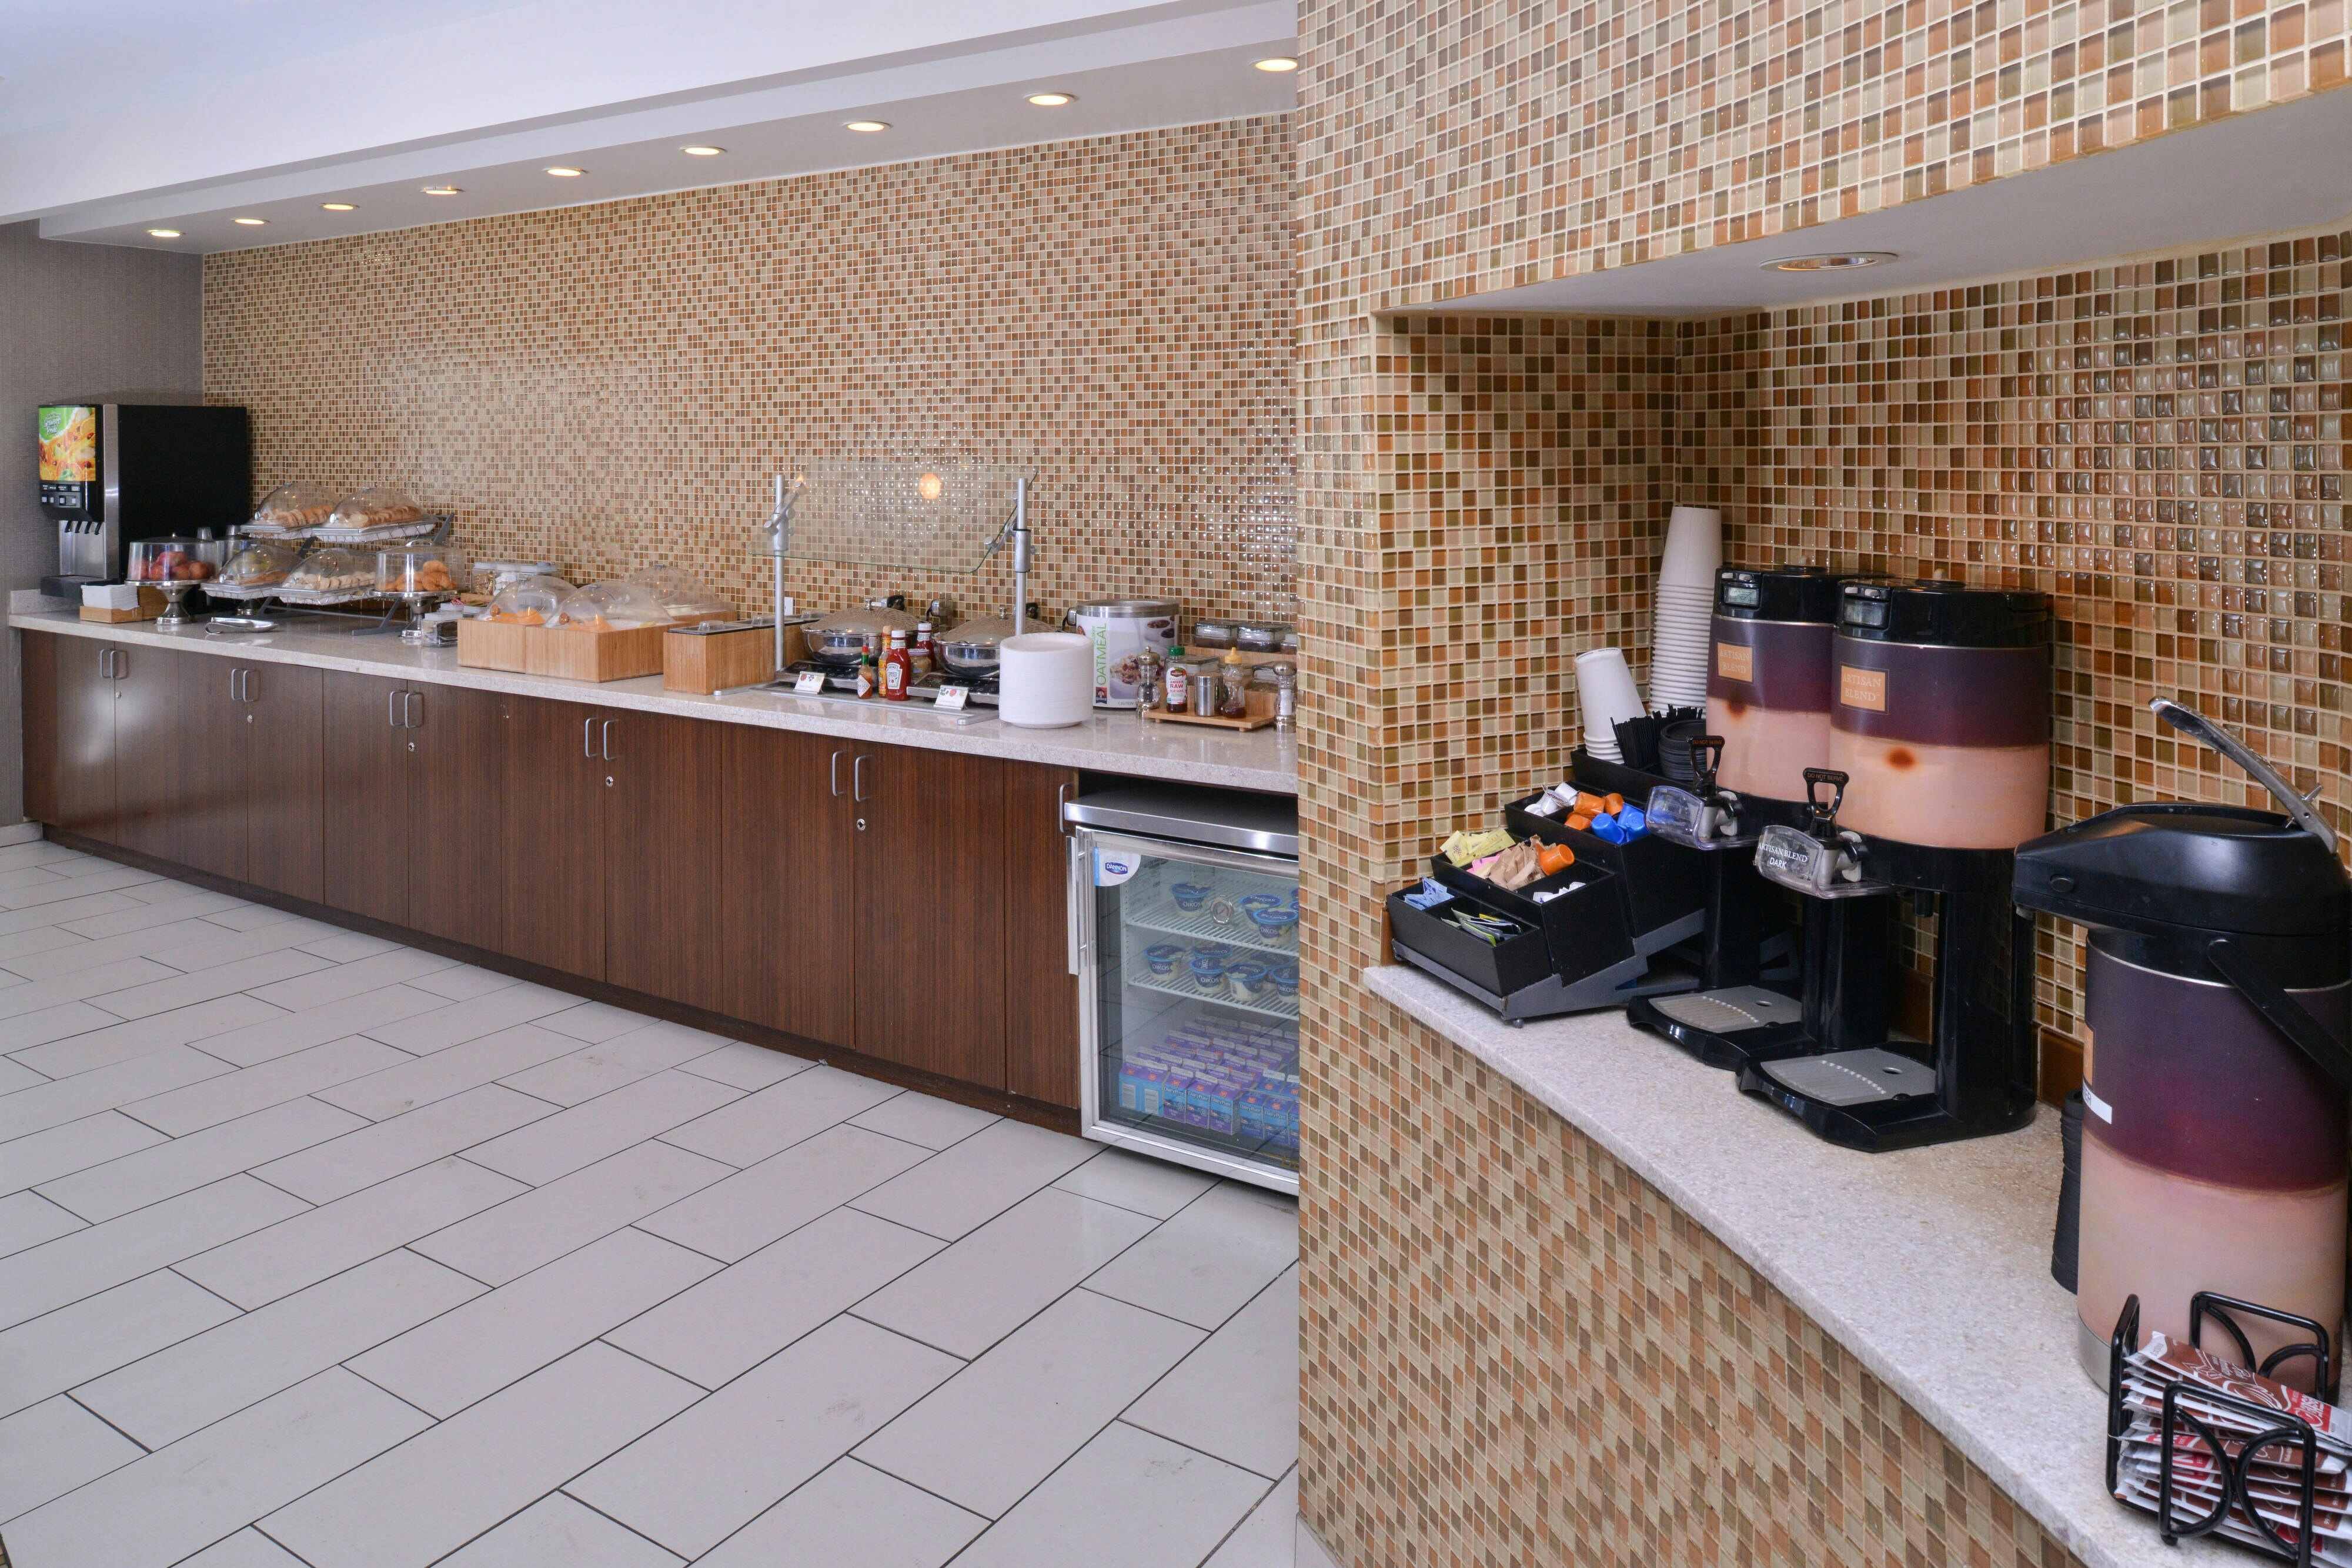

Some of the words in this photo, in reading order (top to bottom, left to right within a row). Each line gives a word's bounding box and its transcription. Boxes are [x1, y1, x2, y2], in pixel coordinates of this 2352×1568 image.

[1096, 623, 1107, 685] OATMEAL
[1719, 649, 1750, 660] ARTISAN
[1722, 662, 1746, 673] BLEND
[1843, 673, 1881, 687] ARTISAN
[1845, 688, 1876, 701] BLEND
[1758, 842, 1783, 855] ARTISAN
[1784, 850, 1808, 862] BLEND
[1107, 863, 1127, 872] DANNON
[1770, 857, 1786, 870] DARK
[1260, 926, 1279, 935] OIKOS
[1277, 985, 1295, 994] OIKOS
[1164, 1086, 1186, 1095] DairyPure
[1188, 1091, 1208, 1101] DairyPure
[1211, 1096, 1231, 1107] DairyPure
[1240, 1103, 1262, 1114] DairyPure
